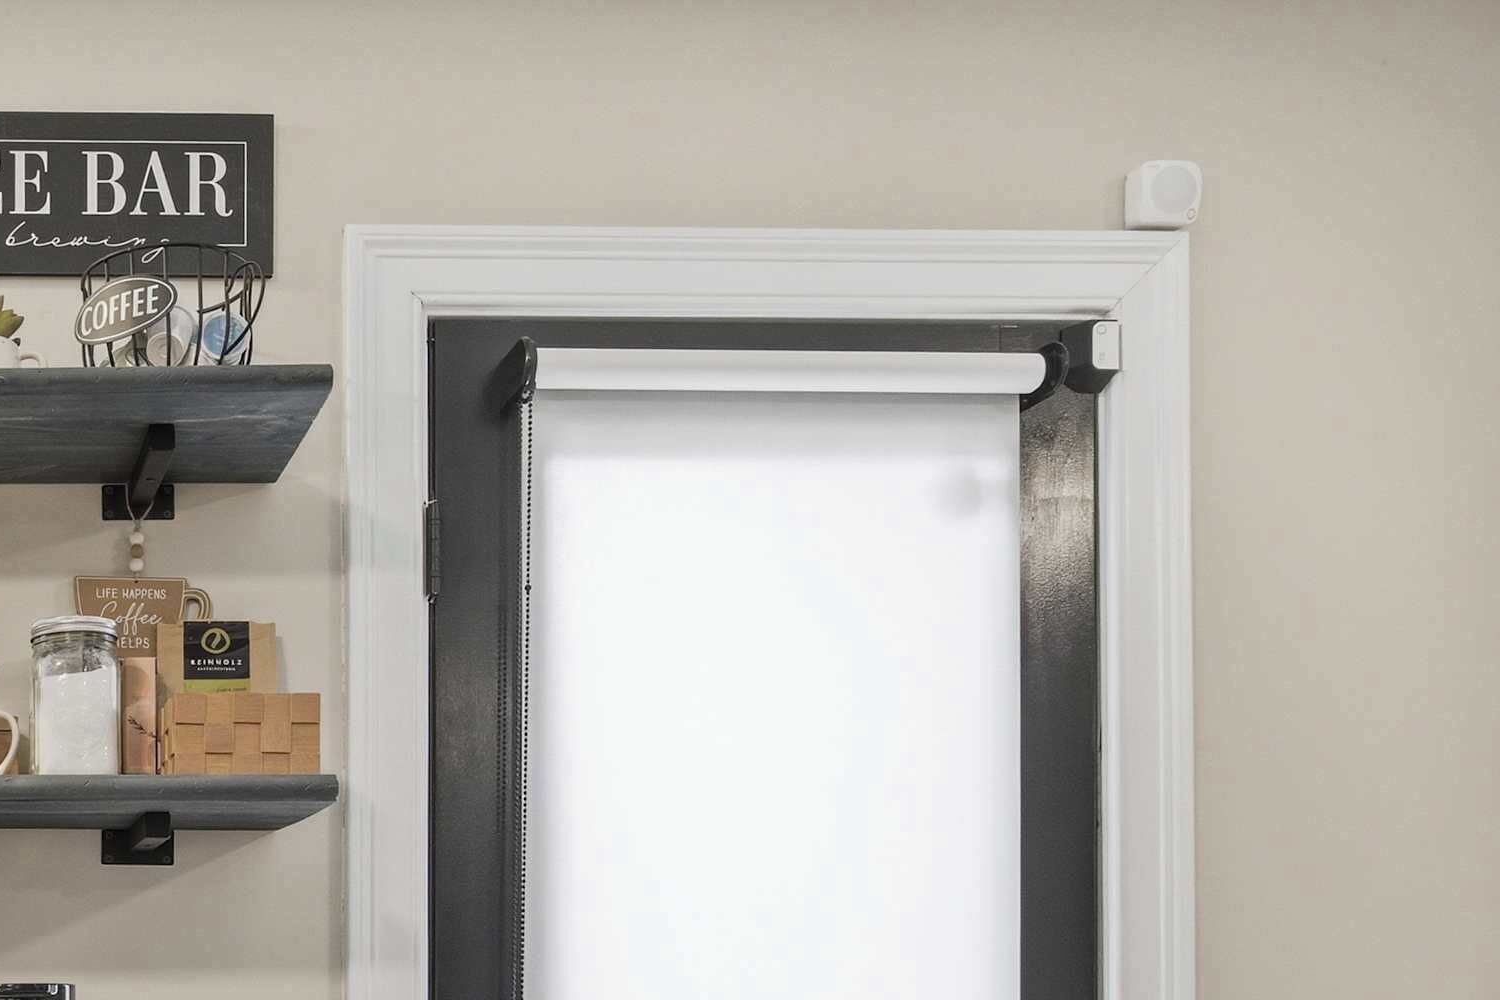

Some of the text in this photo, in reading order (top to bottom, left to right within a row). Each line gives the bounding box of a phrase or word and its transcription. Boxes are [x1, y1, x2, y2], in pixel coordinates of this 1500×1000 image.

[81, 150, 234, 218] BAR
[5, 221, 171, 264] brewing
[80, 284, 160, 337] COFFEE
[95, 587, 167, 600] LIFE HAPPENS
